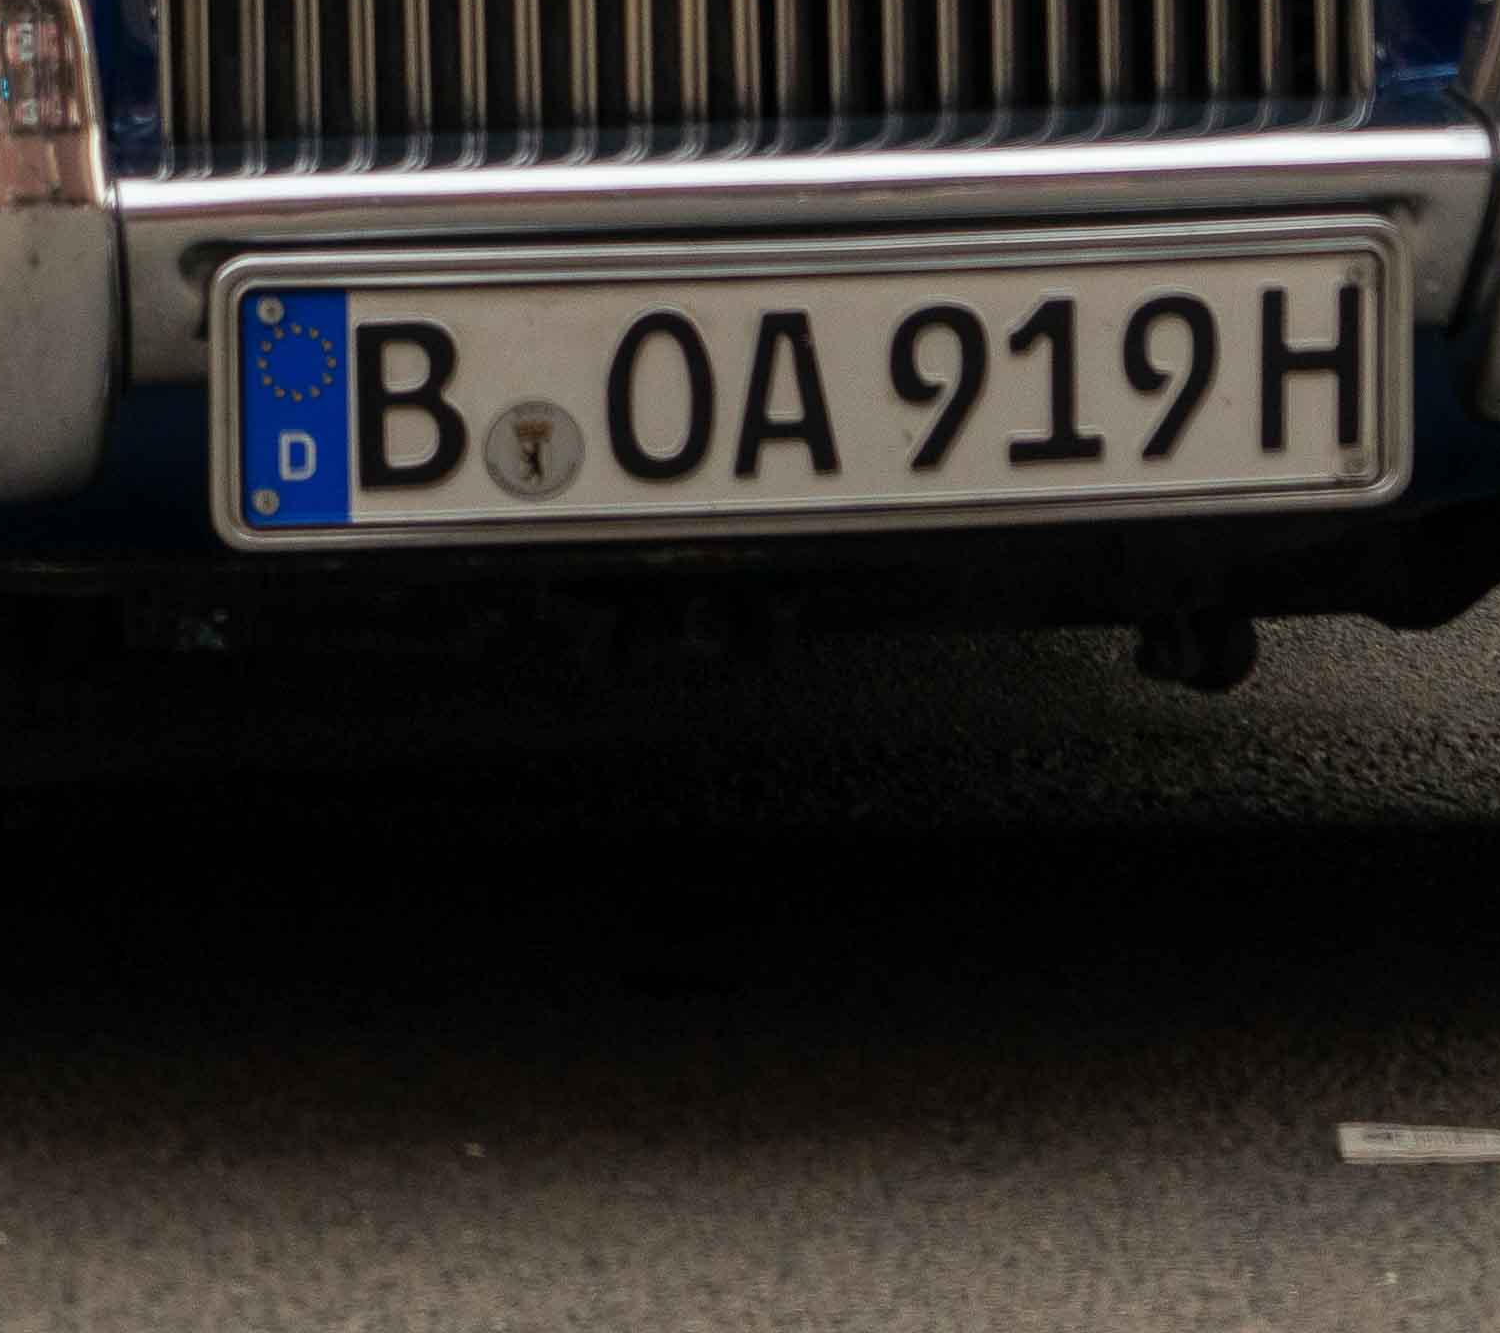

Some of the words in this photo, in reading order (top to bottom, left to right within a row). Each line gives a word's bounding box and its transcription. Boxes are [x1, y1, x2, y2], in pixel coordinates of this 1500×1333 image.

[354, 318, 468, 493] B
[886, 281, 1362, 475] 919H
[278, 430, 317, 482] D
